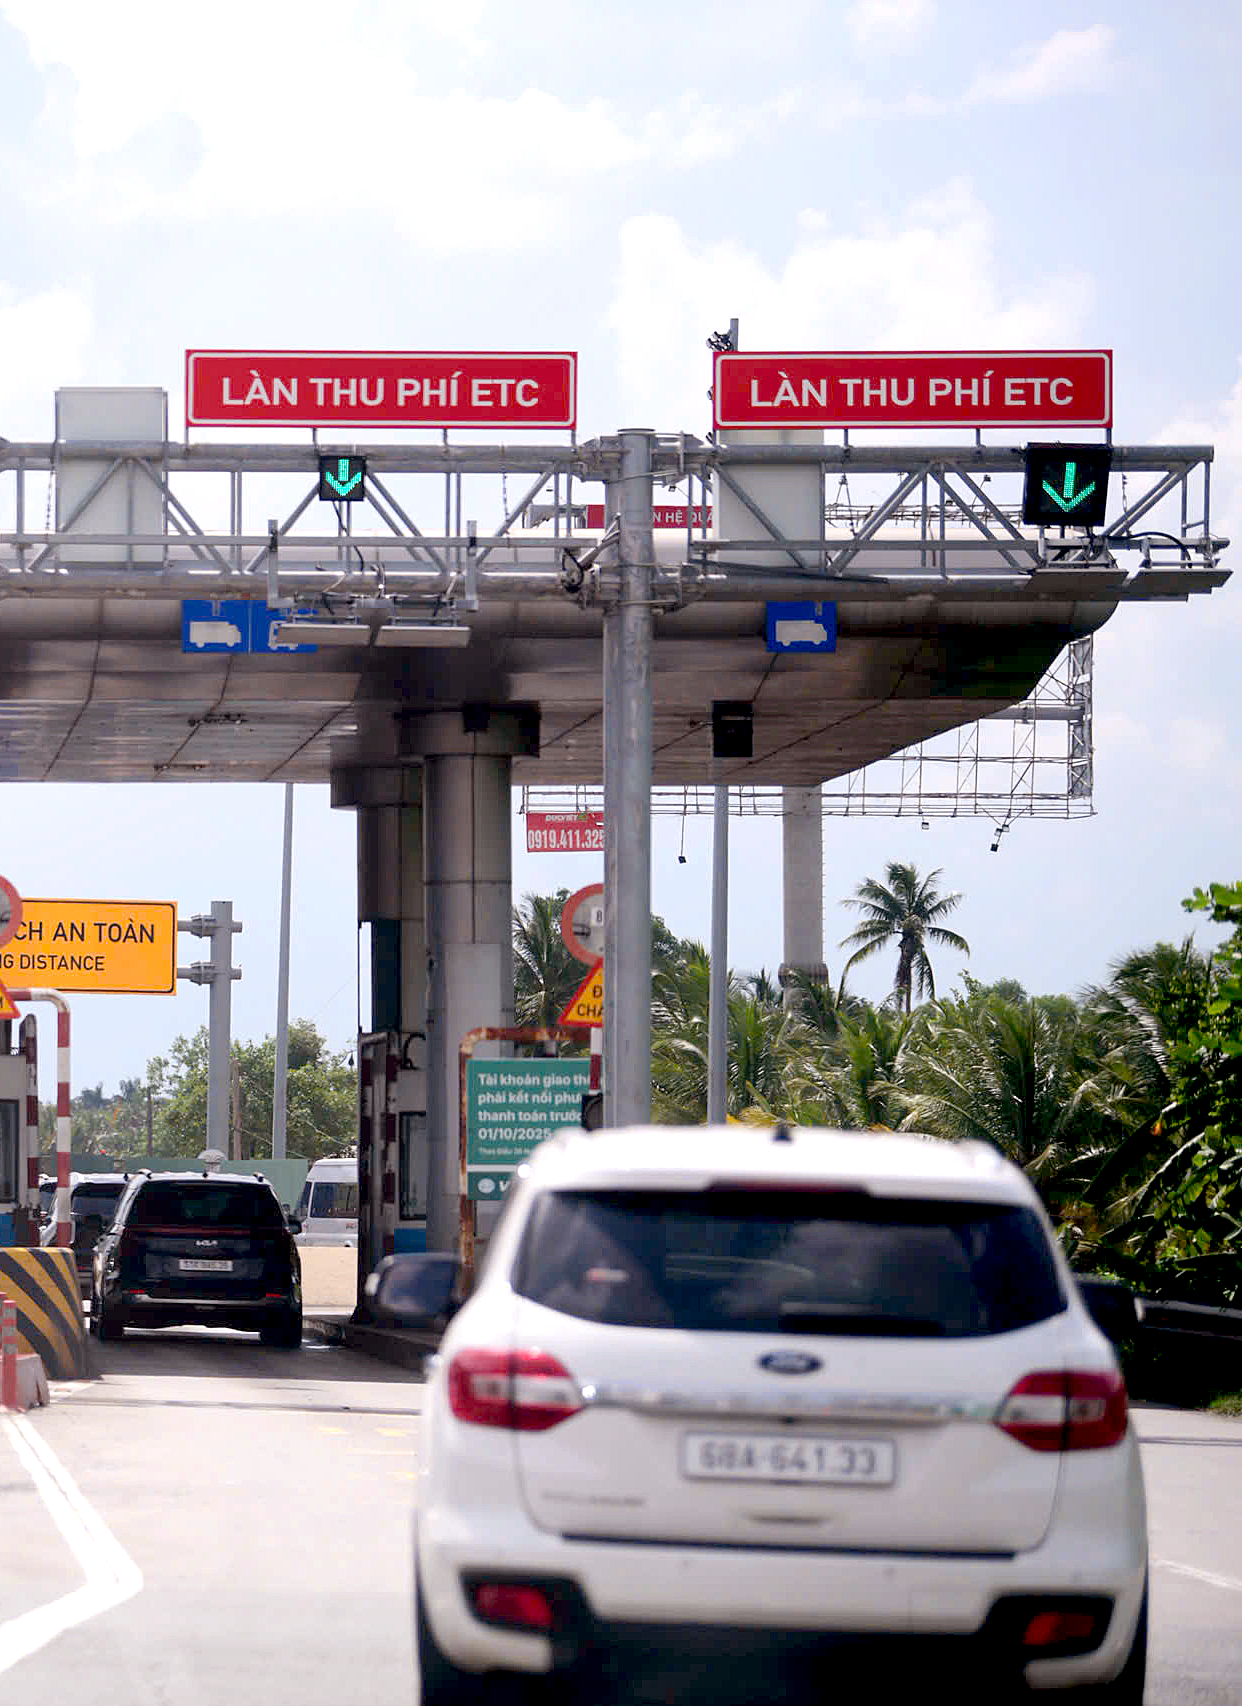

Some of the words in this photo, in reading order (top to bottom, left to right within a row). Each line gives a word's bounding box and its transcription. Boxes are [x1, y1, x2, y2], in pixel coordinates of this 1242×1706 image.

[223, 370, 298, 405] LÀN
[309, 377, 384, 406] THU
[398, 371, 462, 407] PHÍ
[471, 378, 539, 407] ETC
[751, 371, 826, 407] LÀN
[839, 378, 914, 406] THU
[929, 370, 994, 406] PHÍ
[1004, 378, 1073, 406] ETC
[666, 509, 683, 524] HỆ
[14, 921, 43, 942] CH
[53, 922, 85, 942] AN
[94, 918, 155, 943] TOÀN
[20, 954, 105, 971] DISTANCE
[478, 1073, 498, 1086] Tài
[543, 1074, 571, 1088] giao
[478, 1091, 507, 1106] phải
[509, 1092, 529, 1104] kết
[478, 1110, 516, 1121] thanh
[519, 1110, 547, 1121] toán
[478, 1127, 552, 1140] 01/10/2025
